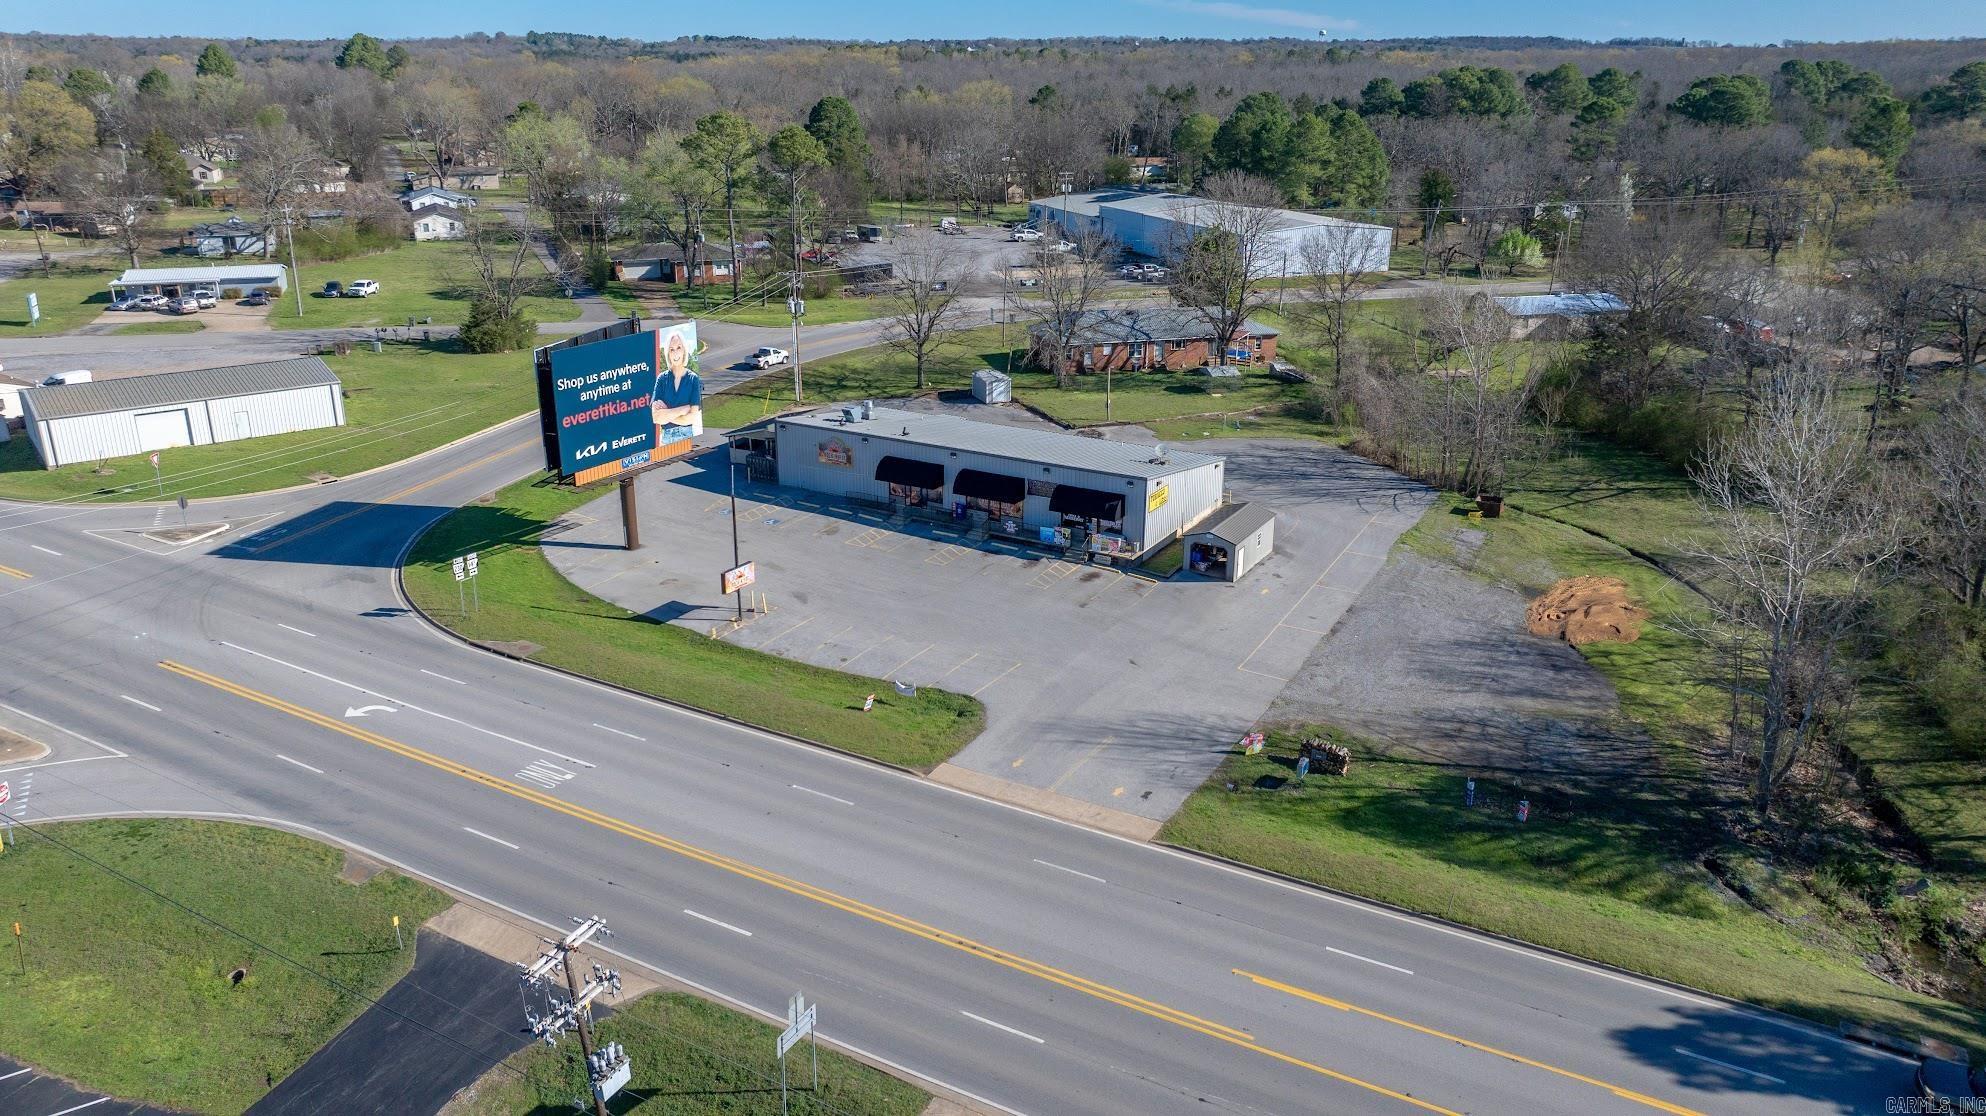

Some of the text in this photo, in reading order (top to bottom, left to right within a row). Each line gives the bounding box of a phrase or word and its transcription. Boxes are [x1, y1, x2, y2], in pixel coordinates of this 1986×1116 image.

[557, 361, 650, 391] Shop us anywhere,
[580, 379, 632, 401] anytime at
[562, 393, 651, 428] everettkia.net
[514, 759, 577, 789] ONLY
